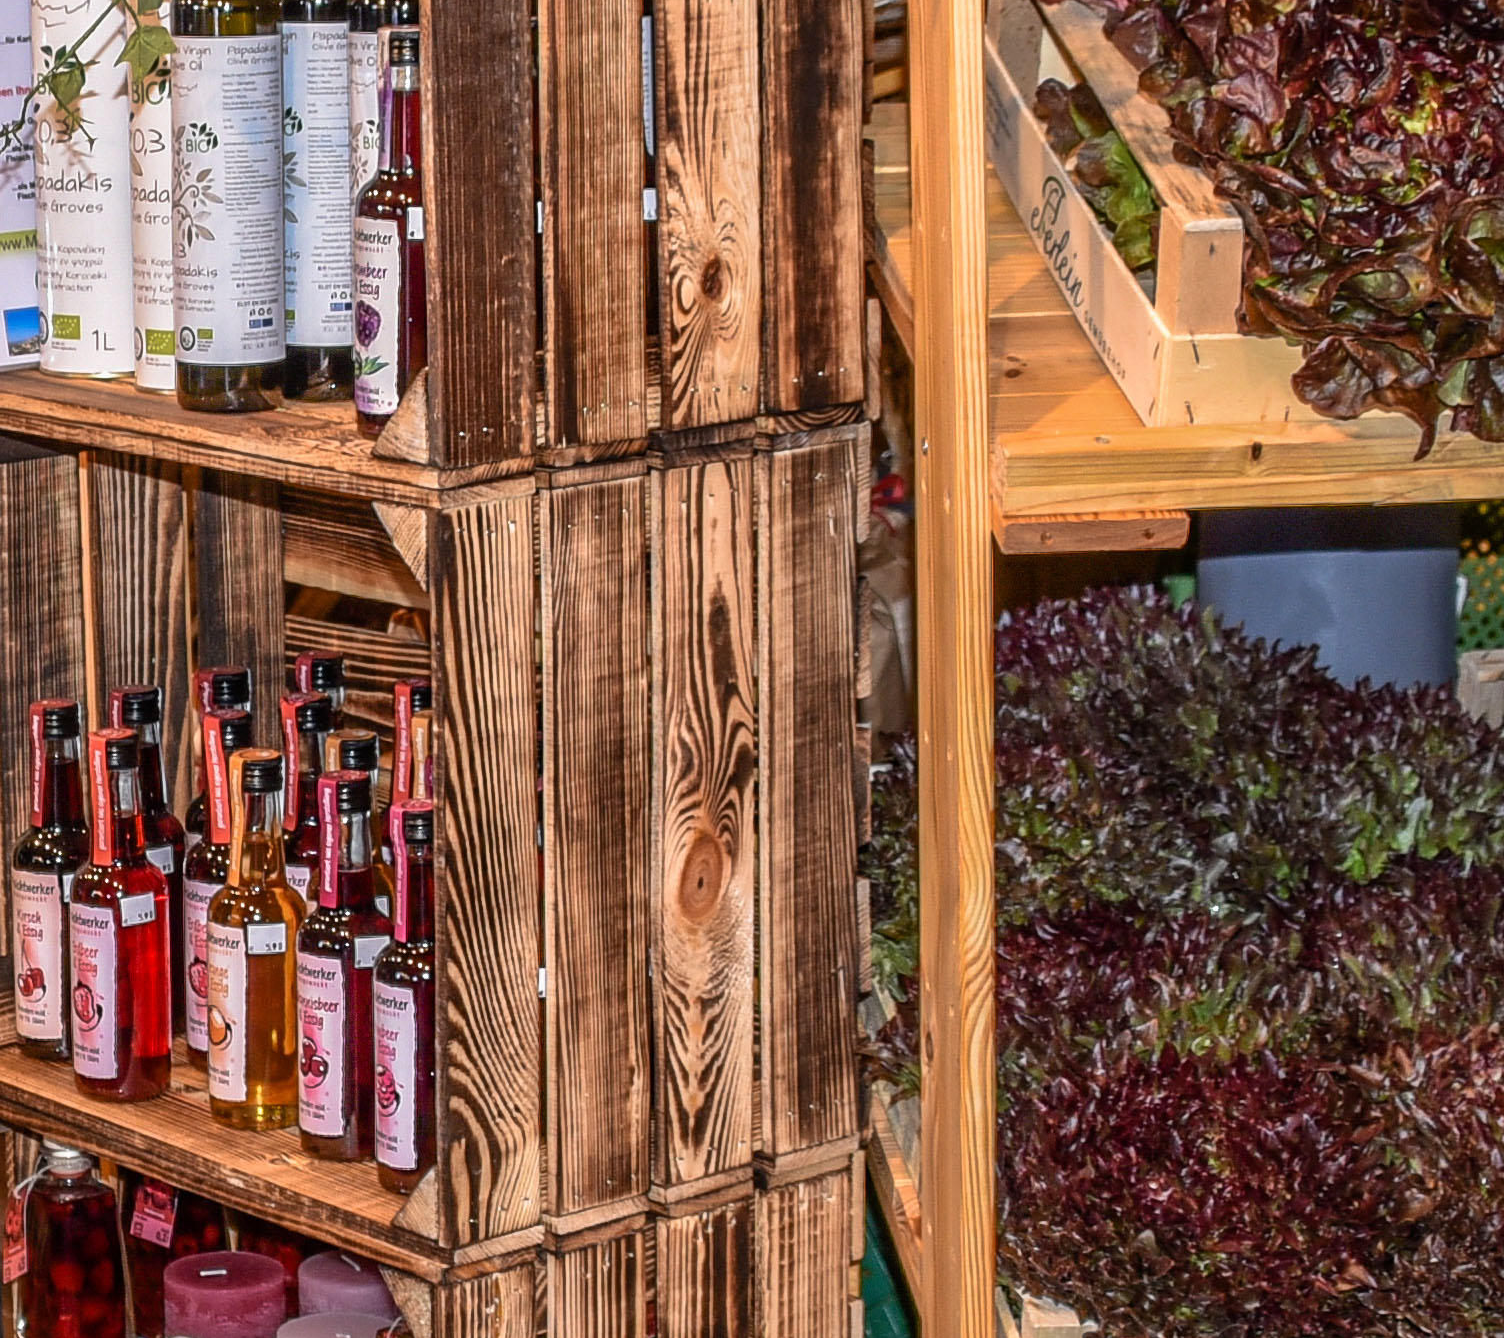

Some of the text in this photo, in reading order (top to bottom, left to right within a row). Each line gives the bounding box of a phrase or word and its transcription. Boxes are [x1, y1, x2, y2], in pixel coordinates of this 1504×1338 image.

[185, 139, 210, 153] BIO
[51, 200, 103, 214] Groves
[359, 282, 381, 300] Essig
[91, 328, 117, 352] 1L
[303, 1011, 323, 1030] Essig
